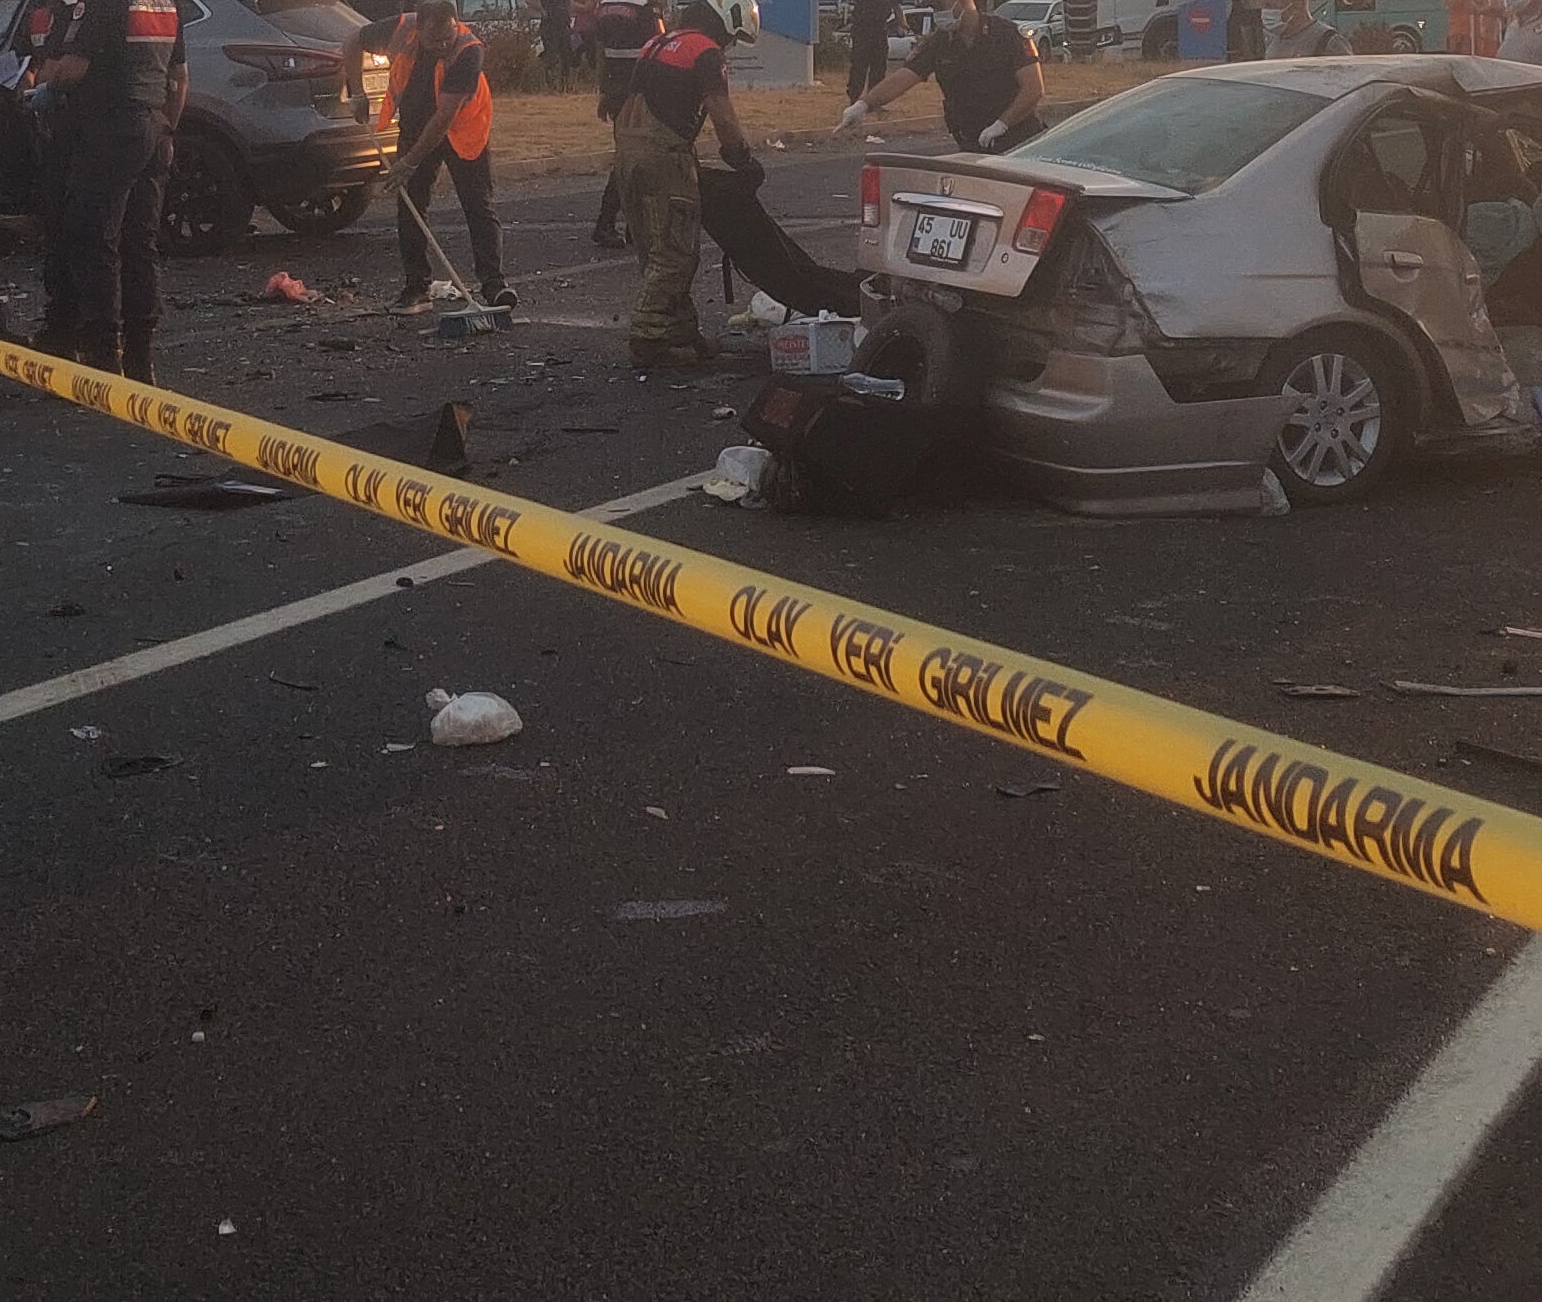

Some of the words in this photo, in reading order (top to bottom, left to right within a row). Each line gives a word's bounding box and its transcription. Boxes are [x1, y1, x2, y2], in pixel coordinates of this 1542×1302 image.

[918, 215, 935, 235] 45
[930, 238, 952, 259] 861
[563, 531, 686, 618] JANDARMA
[729, 585, 813, 659] OLAY
[1192, 737, 1492, 906] JANDARMA
